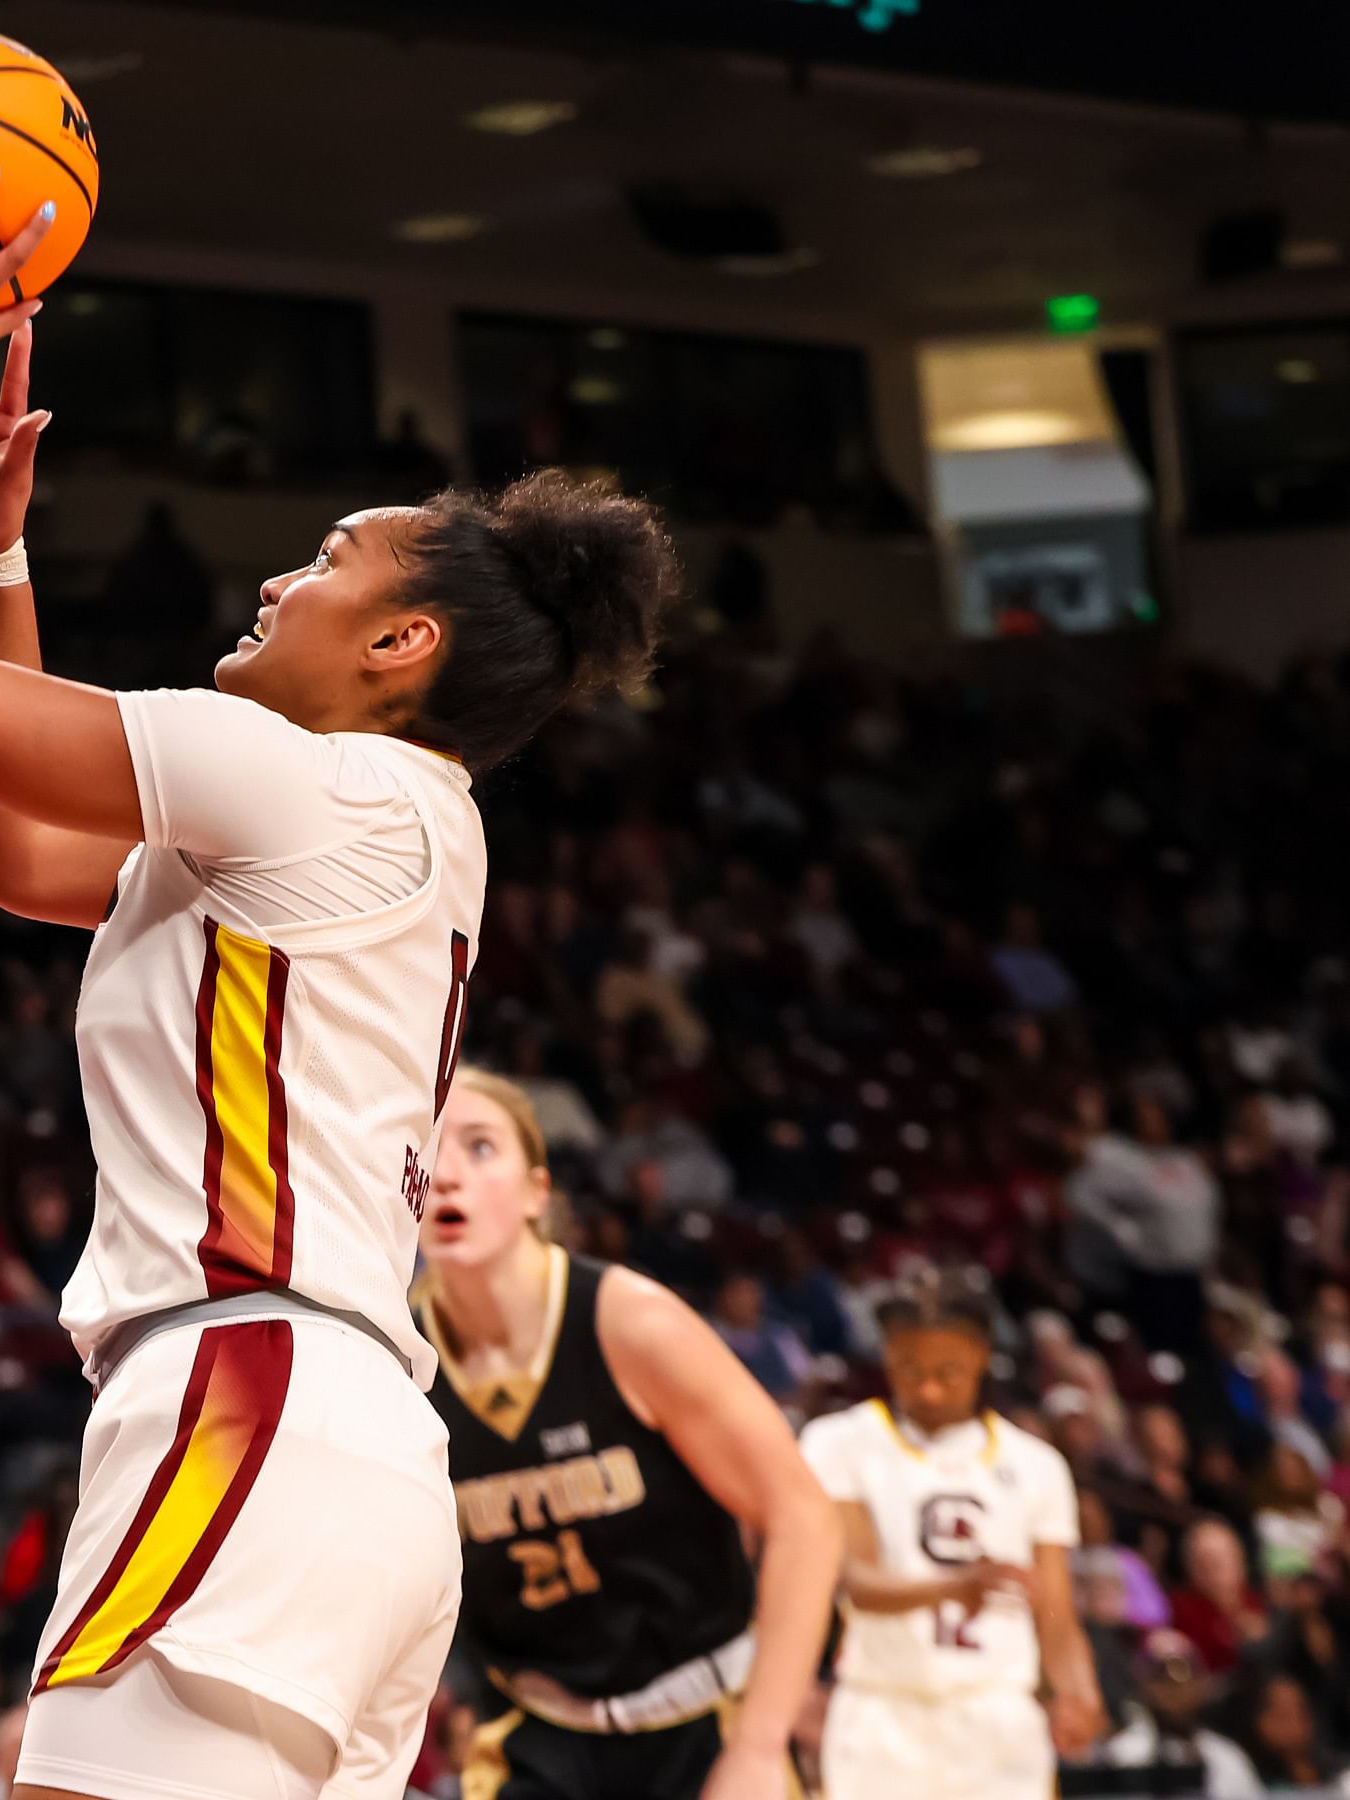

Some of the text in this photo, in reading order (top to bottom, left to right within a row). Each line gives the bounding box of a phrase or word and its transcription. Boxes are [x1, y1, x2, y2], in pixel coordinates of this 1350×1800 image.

[433, 928, 468, 1125] 0
[451, 1446, 645, 1545] OFFORD
[507, 1529, 599, 1610] 21
